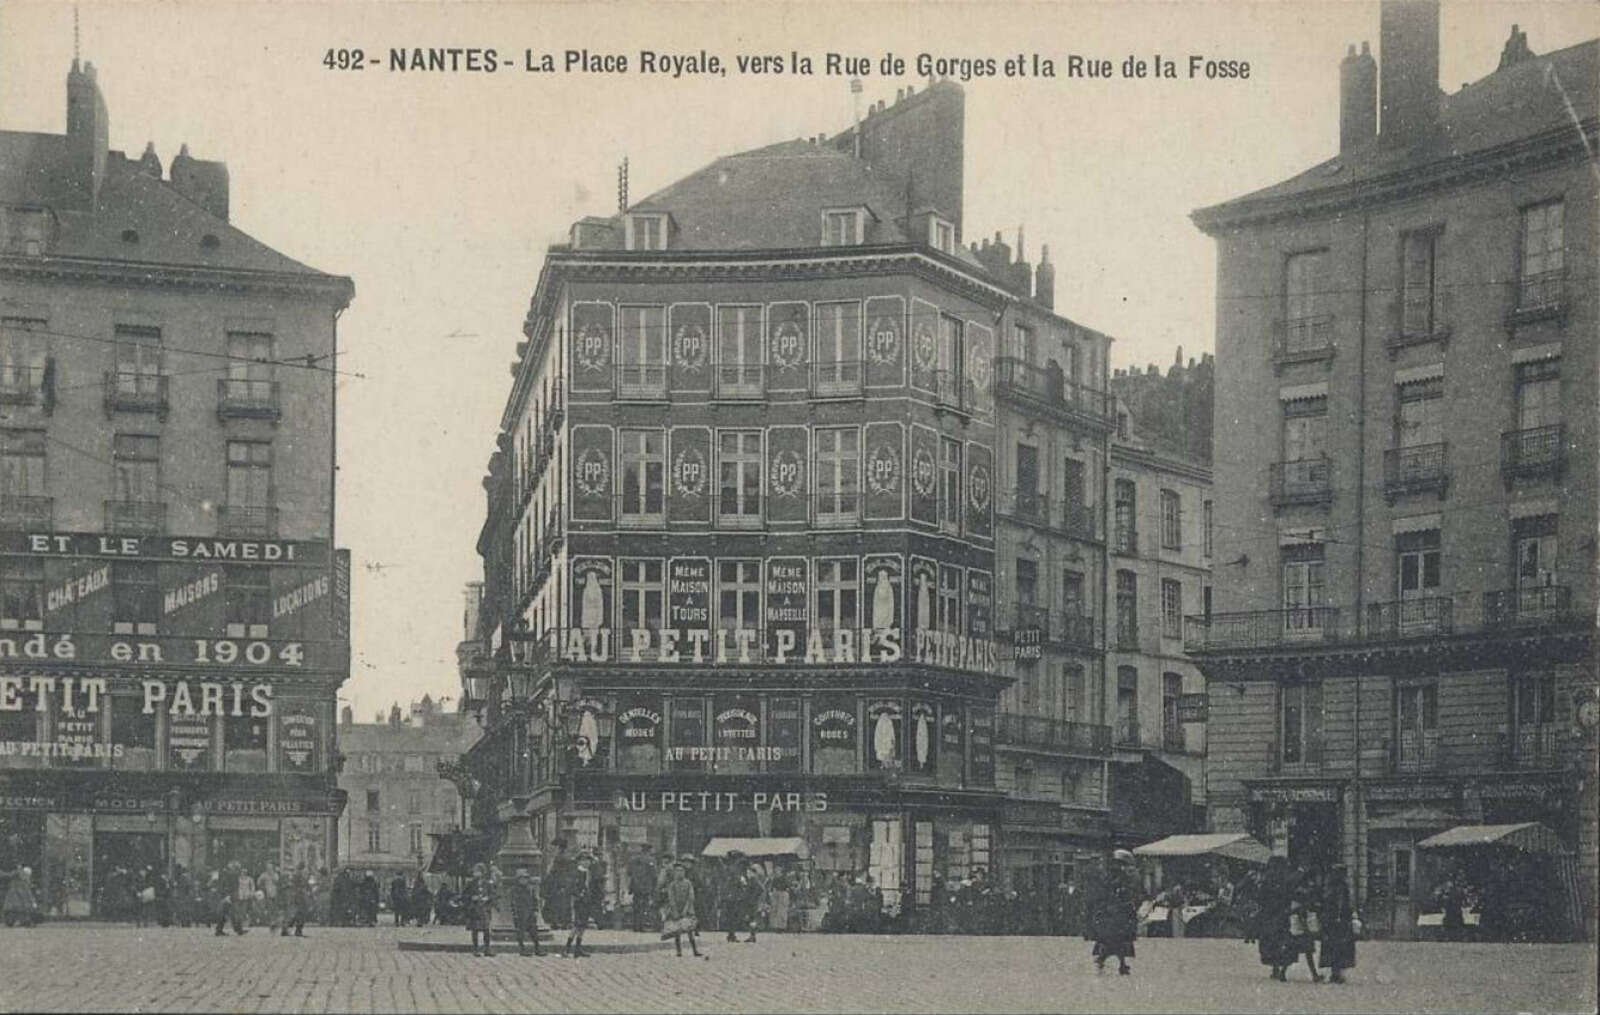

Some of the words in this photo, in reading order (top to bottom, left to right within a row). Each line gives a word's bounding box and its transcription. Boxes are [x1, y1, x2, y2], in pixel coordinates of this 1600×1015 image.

[585, 338, 602, 356] PP
[683, 338, 700, 356] PP
[780, 336, 798, 354] PP
[876, 332, 894, 350] PP
[585, 463, 602, 480] PP
[683, 463, 700, 480] PP
[875, 459, 893, 476] PP
[29, 535, 71, 552] ET
[99, 538, 139, 555] LE
[171, 541, 295, 560] SAMEDI
[164, 573, 218, 614] MAISONS
[671, 580, 709, 593] MAISON
[273, 576, 329, 617] LOCATIONS
[672, 605, 708, 621] TOURS
[0, 633, 75, 659] ndé
[110, 641, 164, 662] en
[194, 639, 304, 665] 1904
[567, 627, 611, 663] AU
[630, 629, 755, 664] PETIT
[775, 627, 903, 665] PARIS
[958, 634, 997, 676] PARIS
[1014, 645, 1041, 660] PARIS
[142, 680, 273, 718] PARIS
[665, 746, 684, 761] AU
[690, 746, 732, 761] PETIT
[738, 746, 782, 761] PARIS
[661, 792, 738, 812] PETIT
[753, 793, 828, 812] PARS
